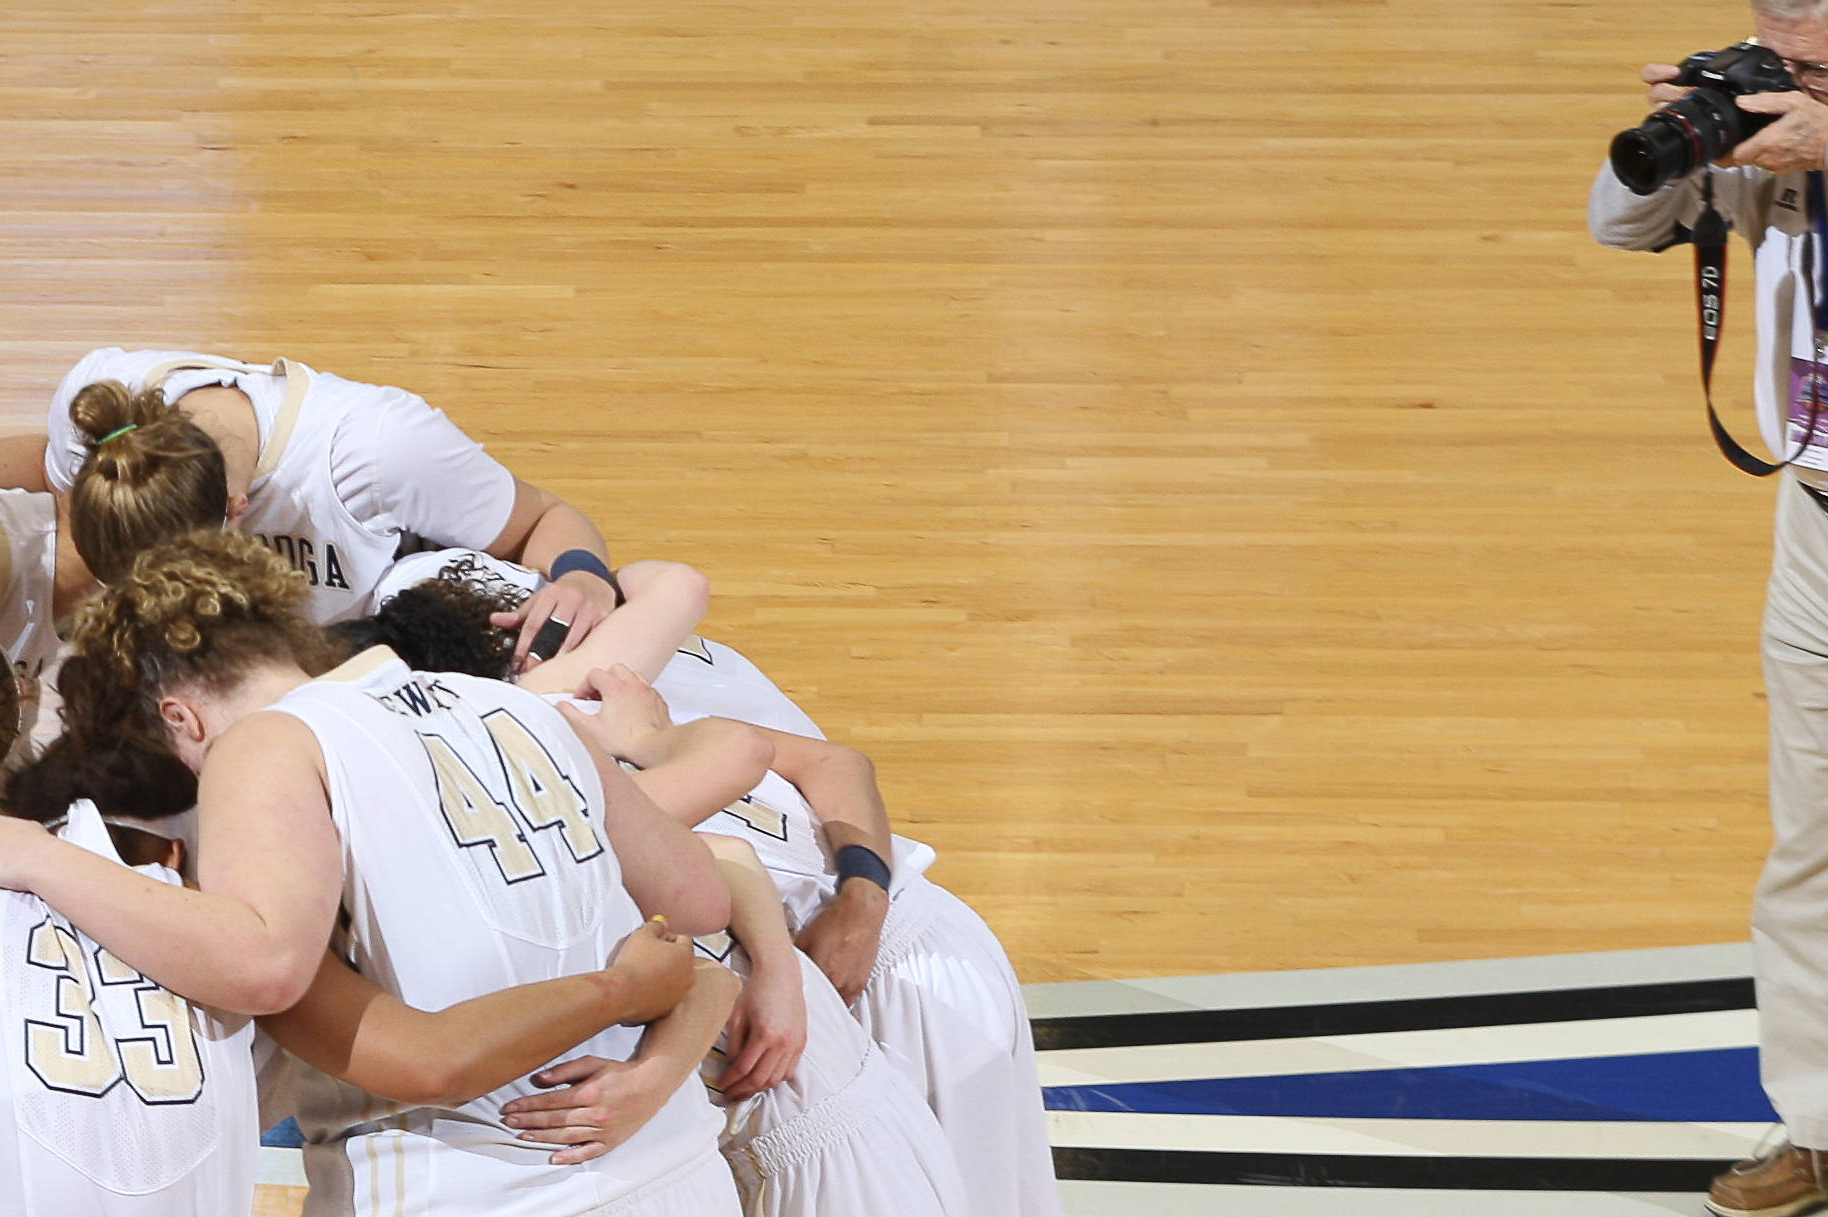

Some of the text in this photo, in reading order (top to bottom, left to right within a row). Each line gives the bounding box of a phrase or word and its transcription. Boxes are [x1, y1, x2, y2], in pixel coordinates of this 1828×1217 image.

[1702, 266, 1719, 287] 7D
[413, 707, 605, 886] 44
[24, 914, 206, 1106] 33
